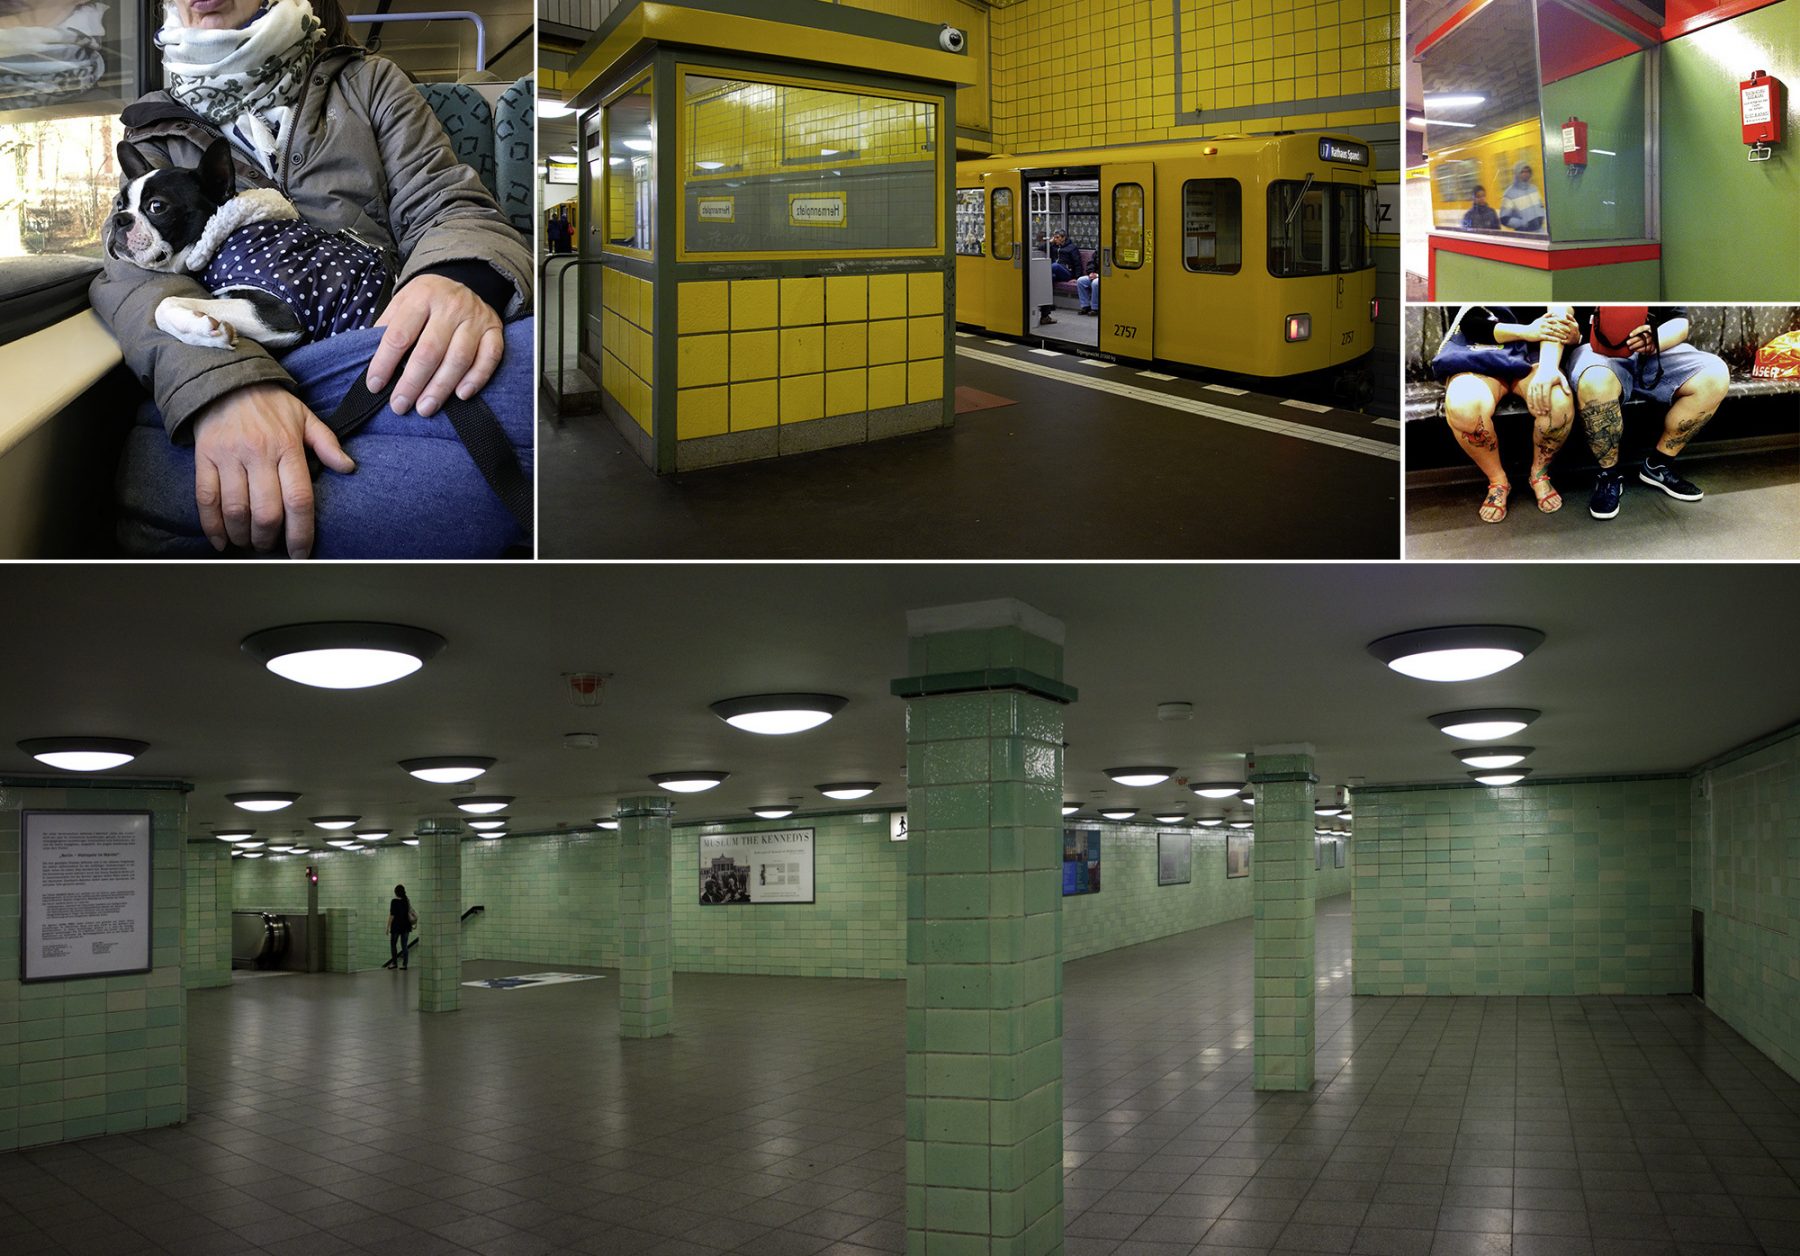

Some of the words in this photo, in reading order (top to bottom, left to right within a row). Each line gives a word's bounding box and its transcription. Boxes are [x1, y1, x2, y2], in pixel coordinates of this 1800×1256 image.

[1331, 146, 1347, 160] Rathaus
[1114, 324, 1137, 339] 2757
[1340, 330, 1354, 346] 2757
[703, 838, 739, 848] MUSEUM
[741, 836, 759, 846] THE
[761, 832, 810, 845] KENNEDYS
